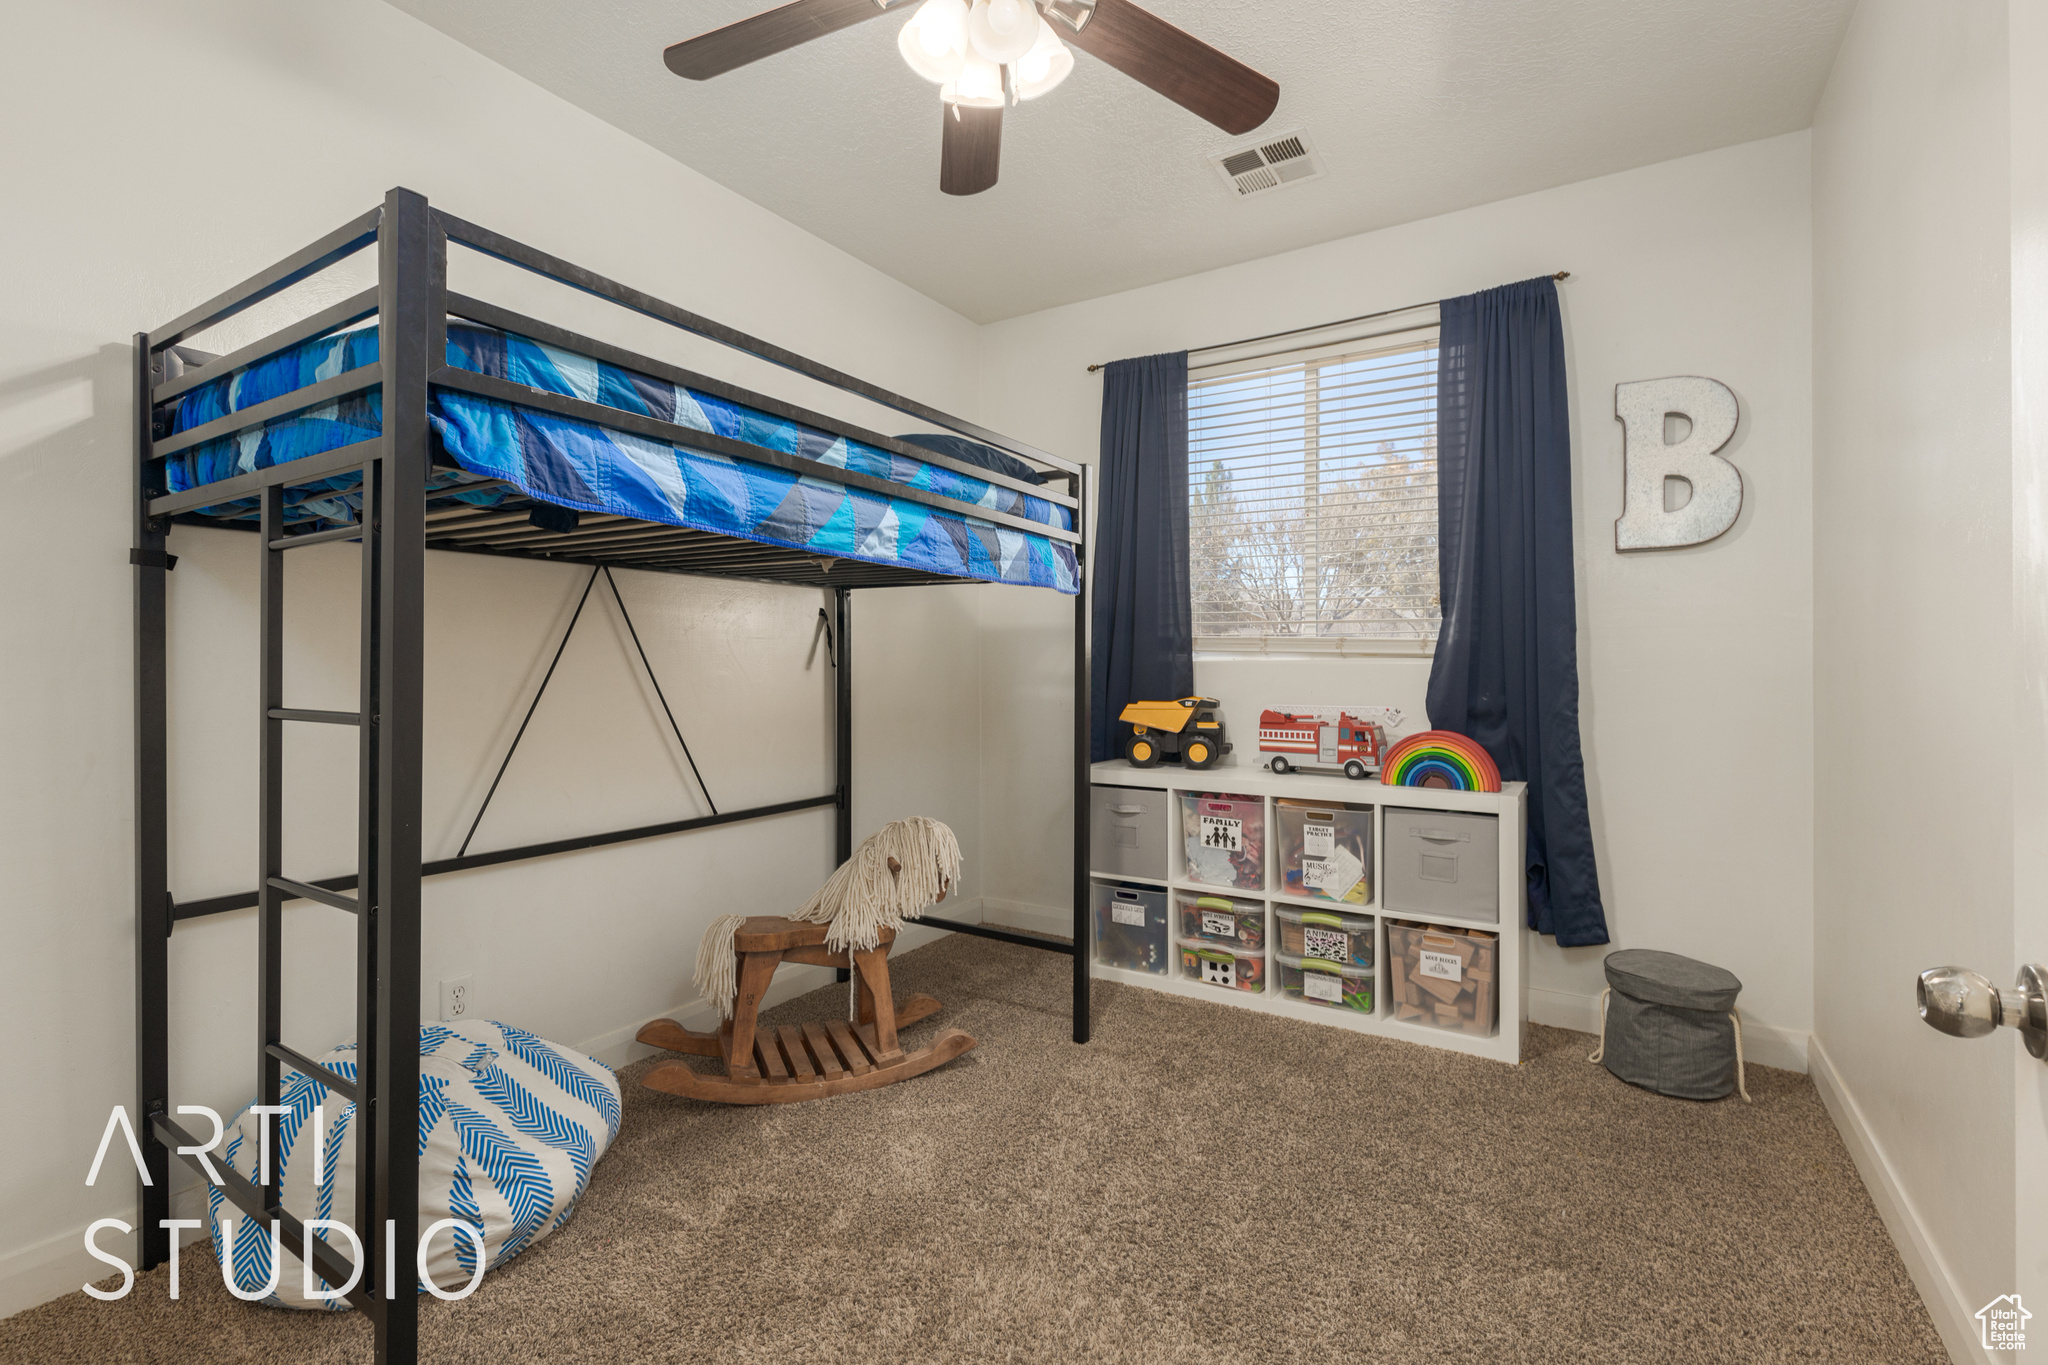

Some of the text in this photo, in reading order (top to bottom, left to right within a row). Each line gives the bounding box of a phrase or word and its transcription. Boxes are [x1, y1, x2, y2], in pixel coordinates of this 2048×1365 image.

[1615, 376, 1744, 554] B
[1203, 817, 1240, 827] FAMILY
[1306, 861, 1331, 871] MUSIC
[1213, 913, 1234, 921] WHEELS
[1305, 929, 1345, 942] ANIMALS
